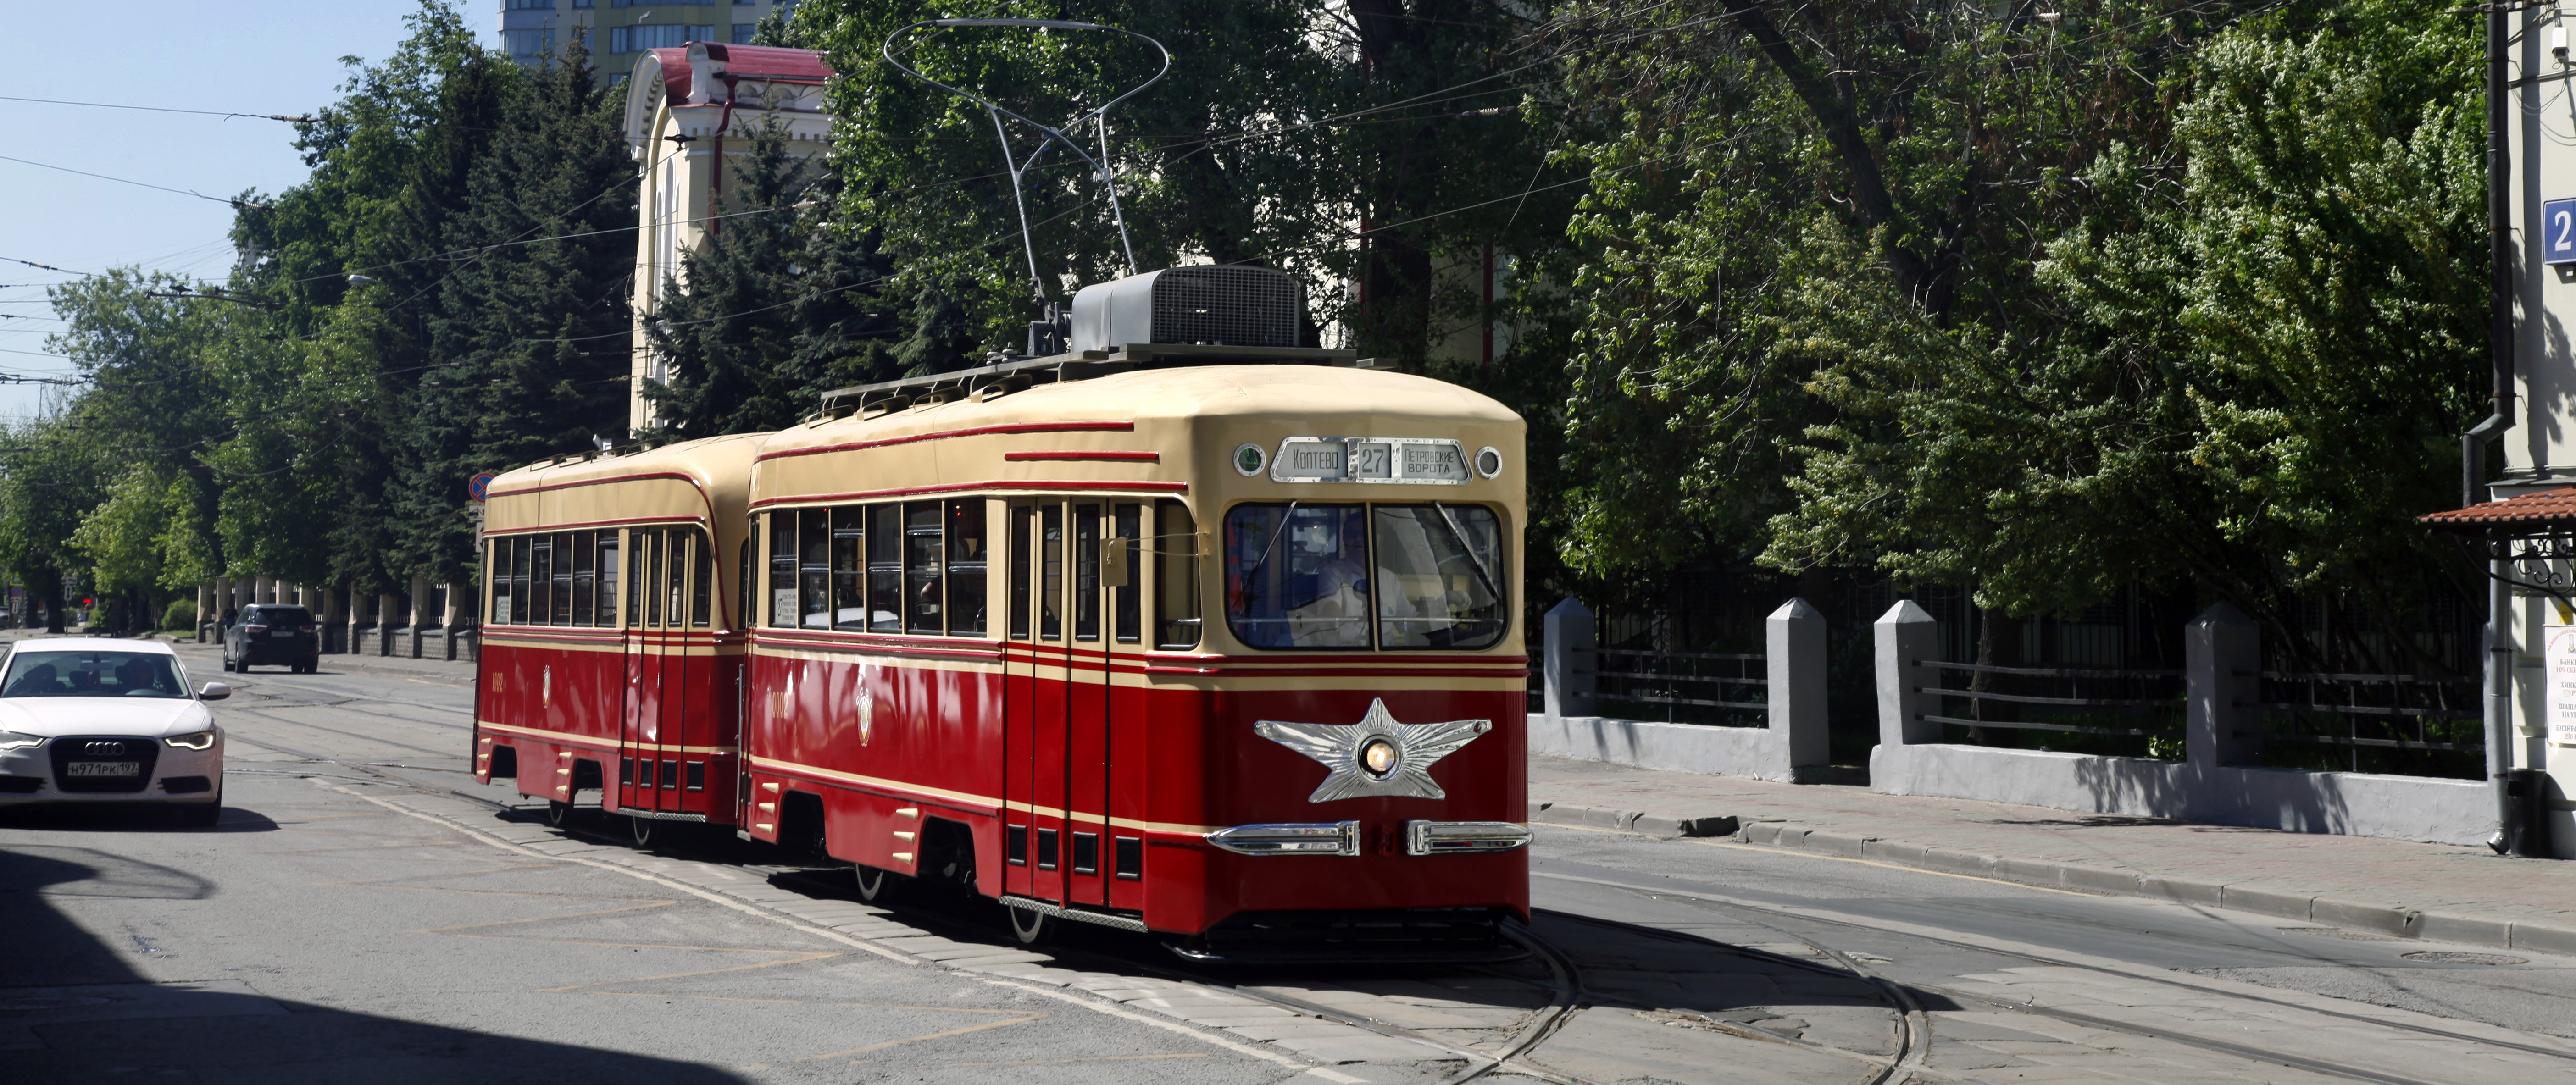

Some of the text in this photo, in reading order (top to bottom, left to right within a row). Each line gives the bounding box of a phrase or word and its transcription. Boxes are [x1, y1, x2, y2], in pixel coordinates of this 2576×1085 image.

[2555, 210, 2572, 251] 2
[1362, 448, 1383, 473] 27
[1405, 448, 1454, 463] ПЕТРОВСКИЕ
[1408, 464, 1450, 473] ВОРОТА
[772, 691, 788, 719] 0002
[119, 763, 136, 771] 197
